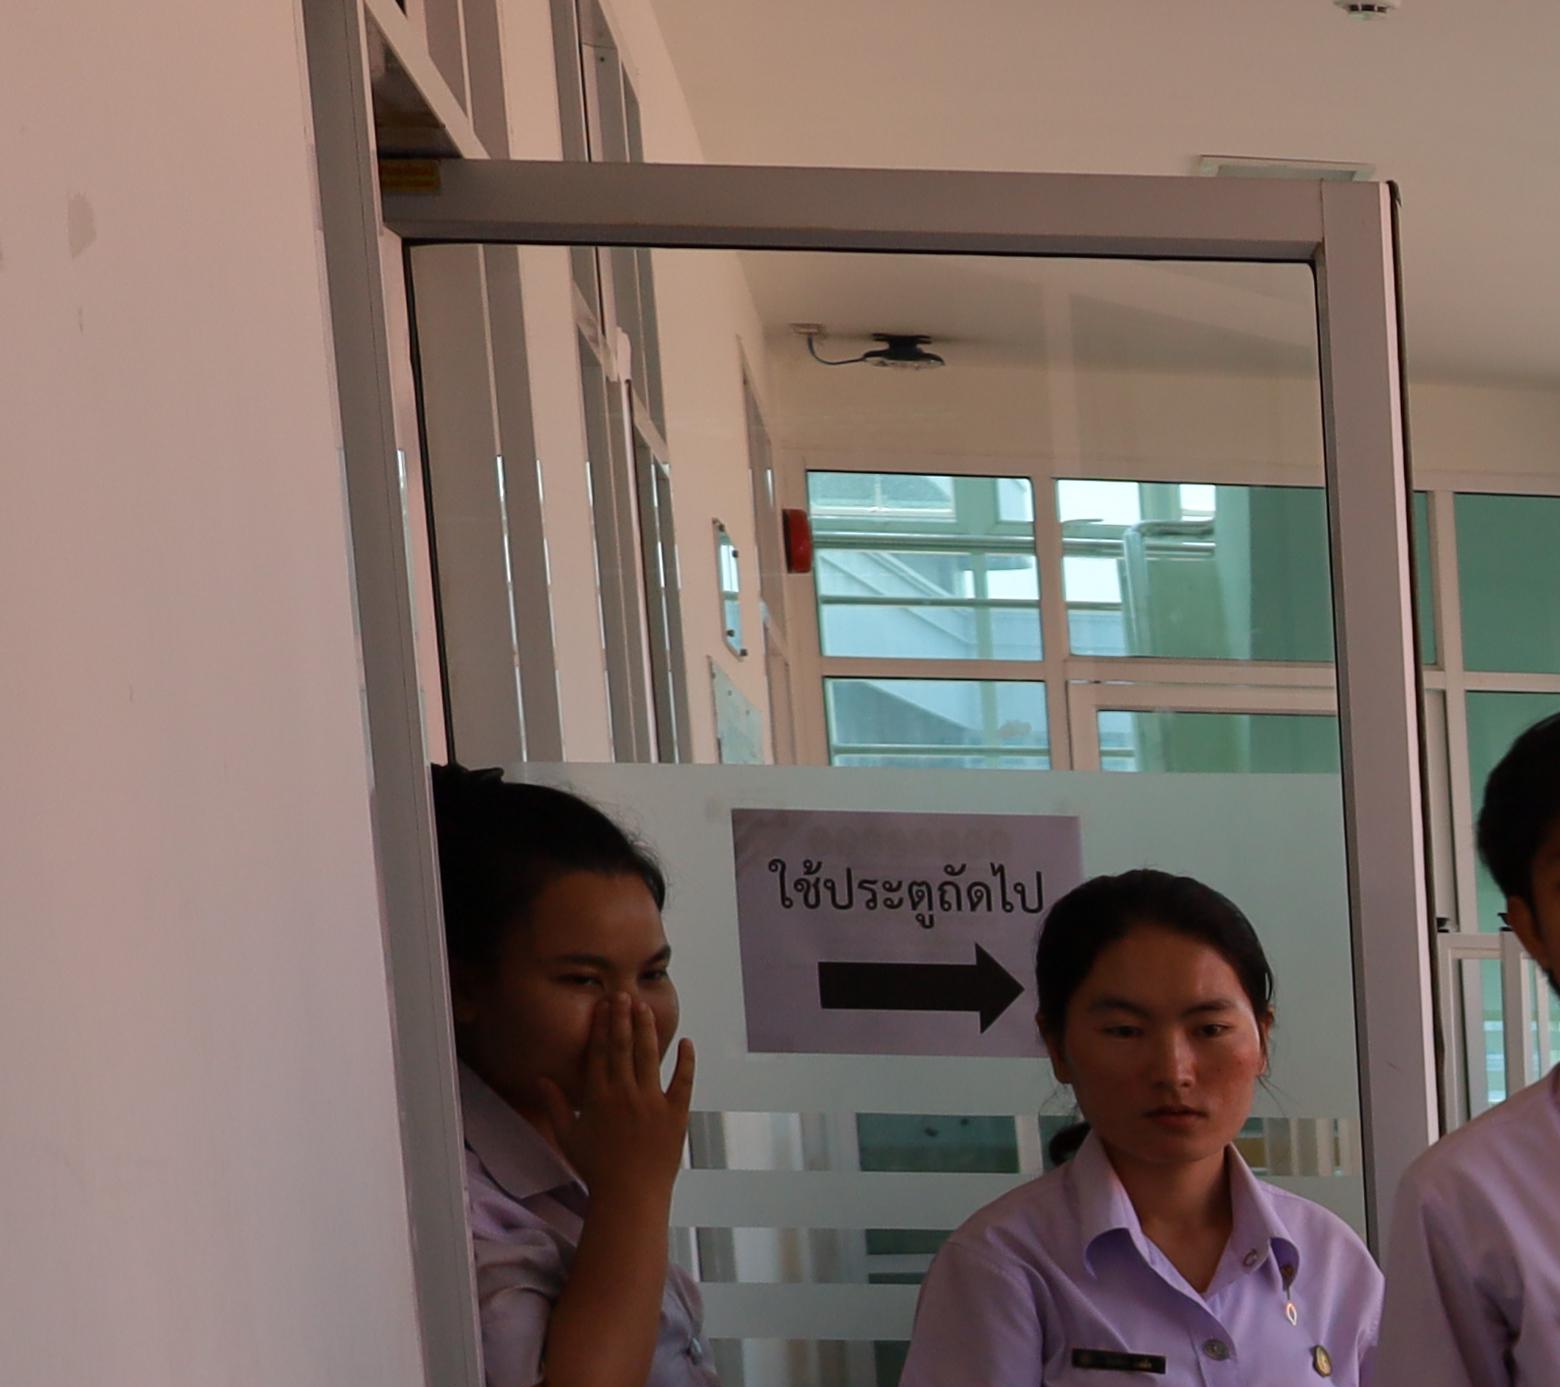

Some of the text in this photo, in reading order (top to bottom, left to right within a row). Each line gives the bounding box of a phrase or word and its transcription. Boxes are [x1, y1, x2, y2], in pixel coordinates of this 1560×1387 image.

[768, 859, 1044, 929] ใช้ประตูถัดไป
